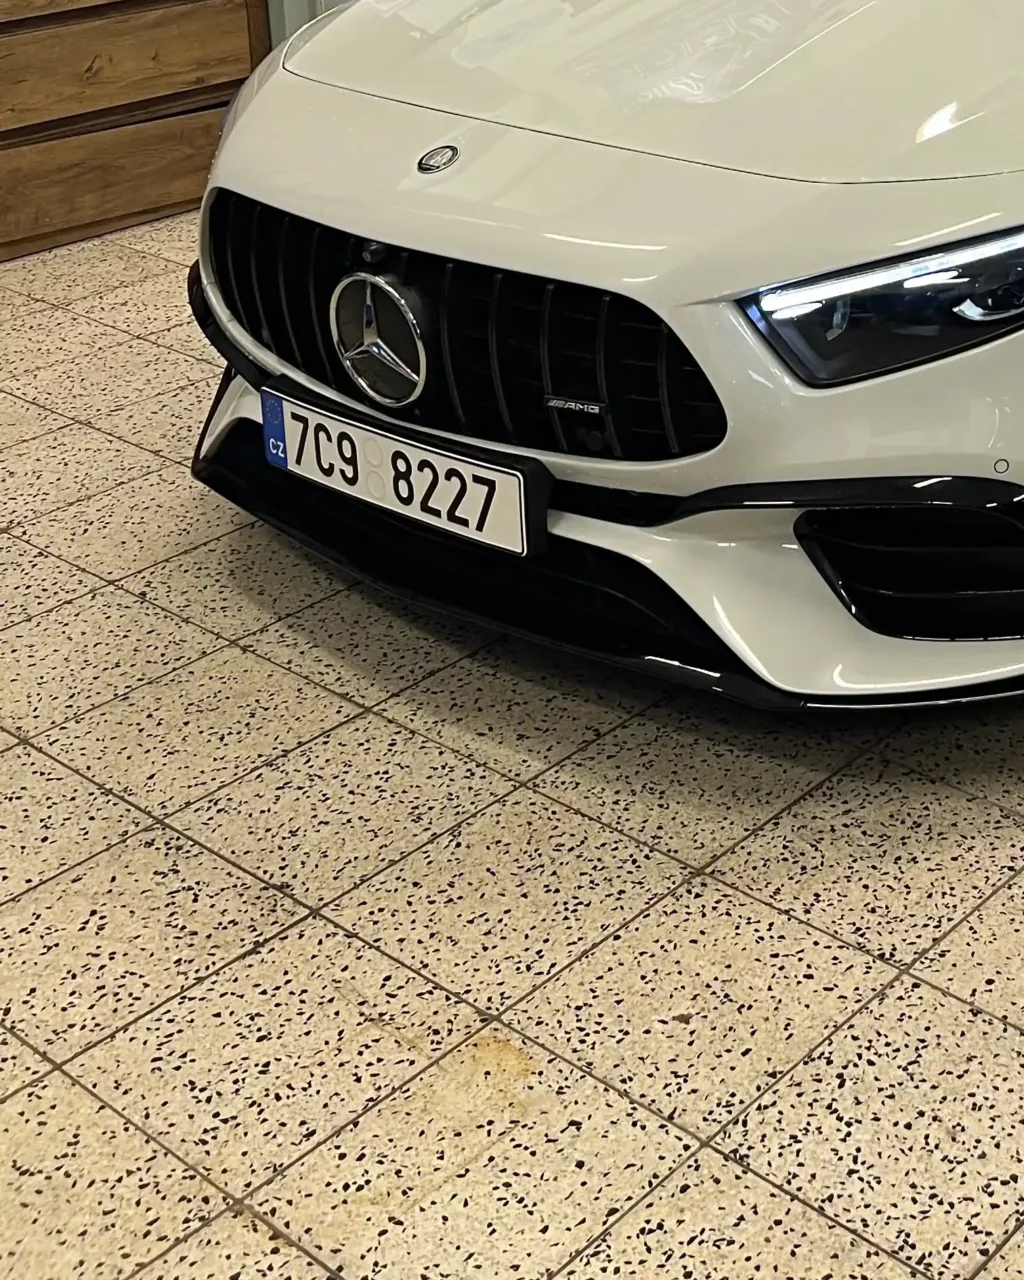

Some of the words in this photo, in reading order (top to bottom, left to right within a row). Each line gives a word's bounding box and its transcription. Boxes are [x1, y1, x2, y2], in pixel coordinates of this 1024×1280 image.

[269, 437, 285, 458] CZ
[290, 411, 359, 486] 7C9
[390, 449, 497, 533] 8227
